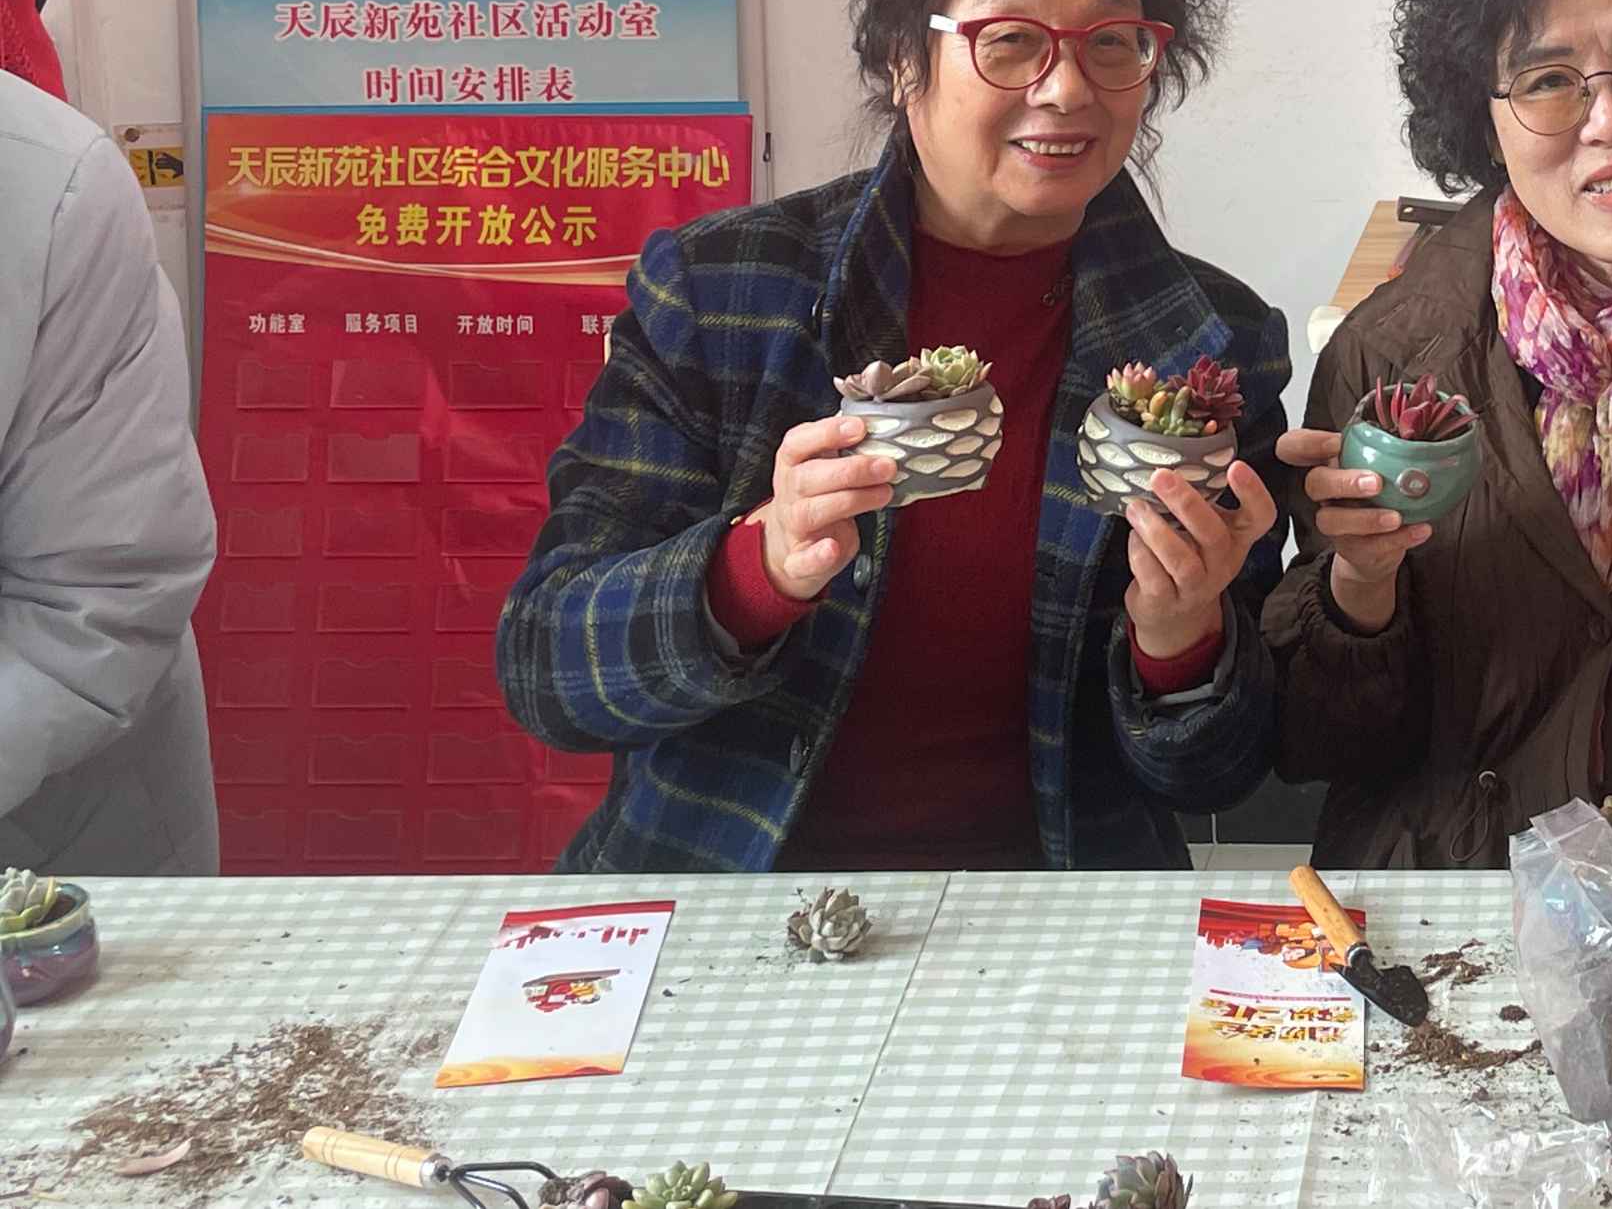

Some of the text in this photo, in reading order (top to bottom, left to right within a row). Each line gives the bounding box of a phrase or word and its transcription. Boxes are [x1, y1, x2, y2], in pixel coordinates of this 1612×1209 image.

[273, 0, 660, 41] 天辰新苑社区活动室
[364, 65, 575, 104] 时间安排表
[226, 143, 732, 191] 天辰新苑社区综合文化服务中心
[355, 203, 599, 248] 免费开放公示
[248, 312, 306, 335] 功能室
[344, 312, 419, 335] 服务项目
[456, 312, 535, 336] 开放时间
